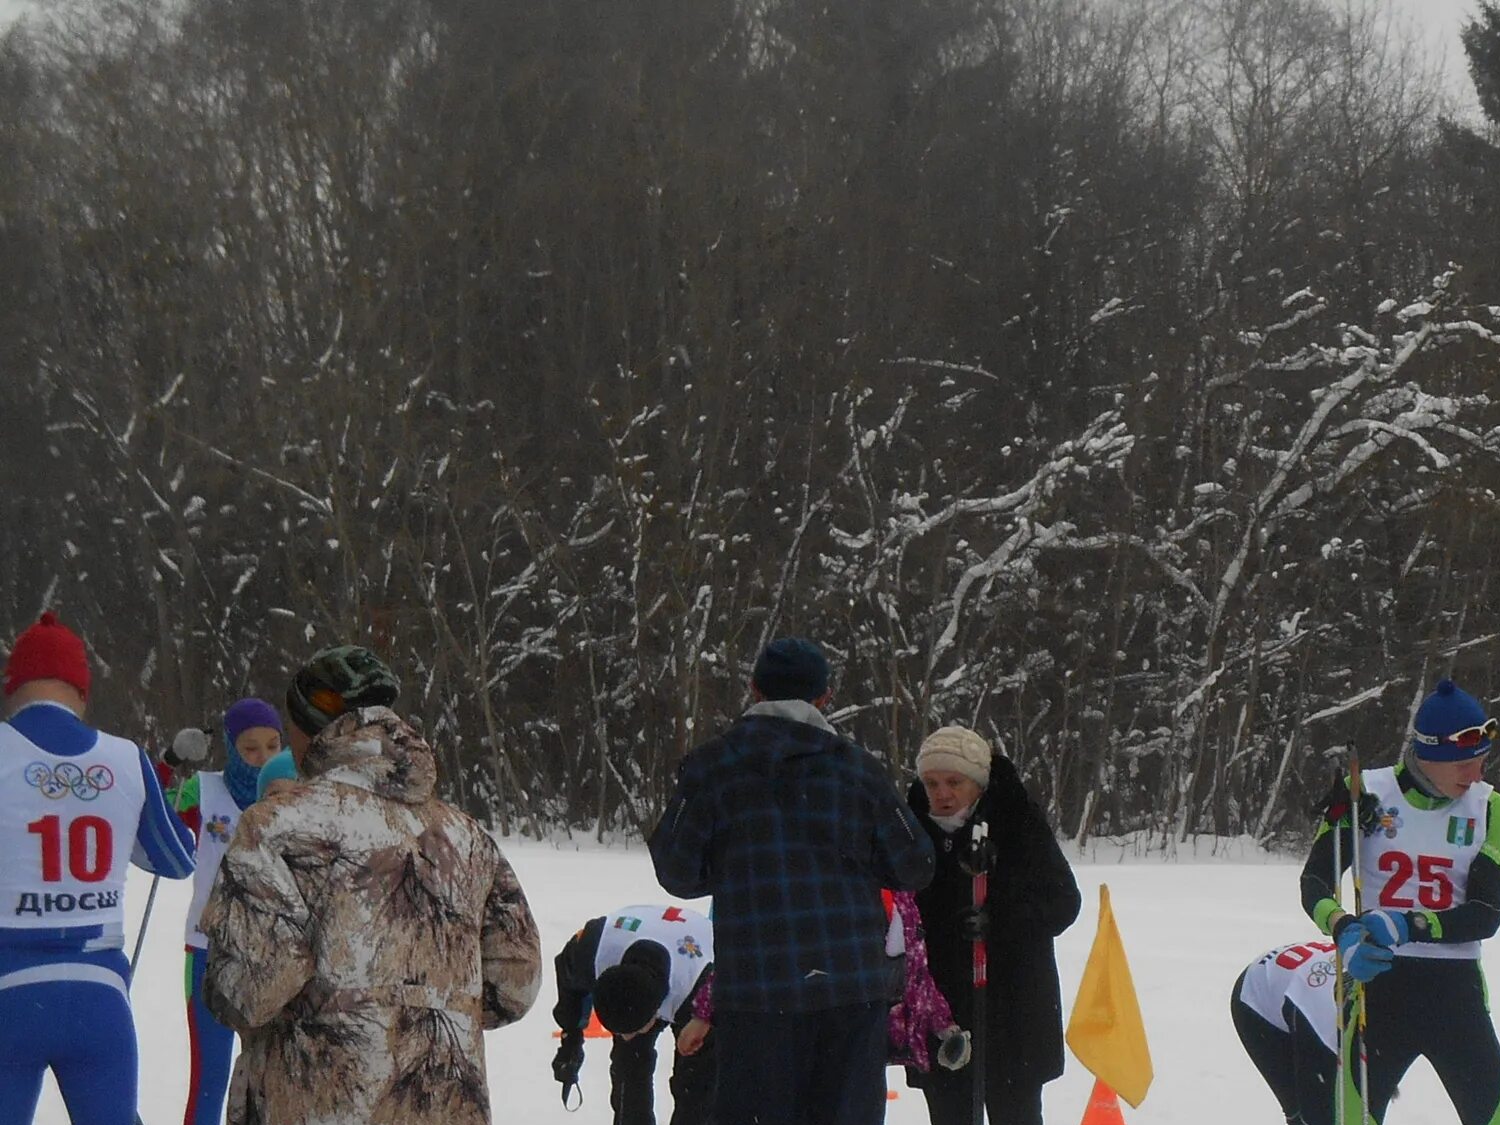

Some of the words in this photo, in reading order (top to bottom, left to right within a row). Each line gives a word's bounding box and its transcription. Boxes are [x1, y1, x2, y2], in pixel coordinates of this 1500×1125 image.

[27, 815, 113, 883] 10
[16, 890, 118, 917] ДЮСШ
[1378, 851, 1454, 911] 25
